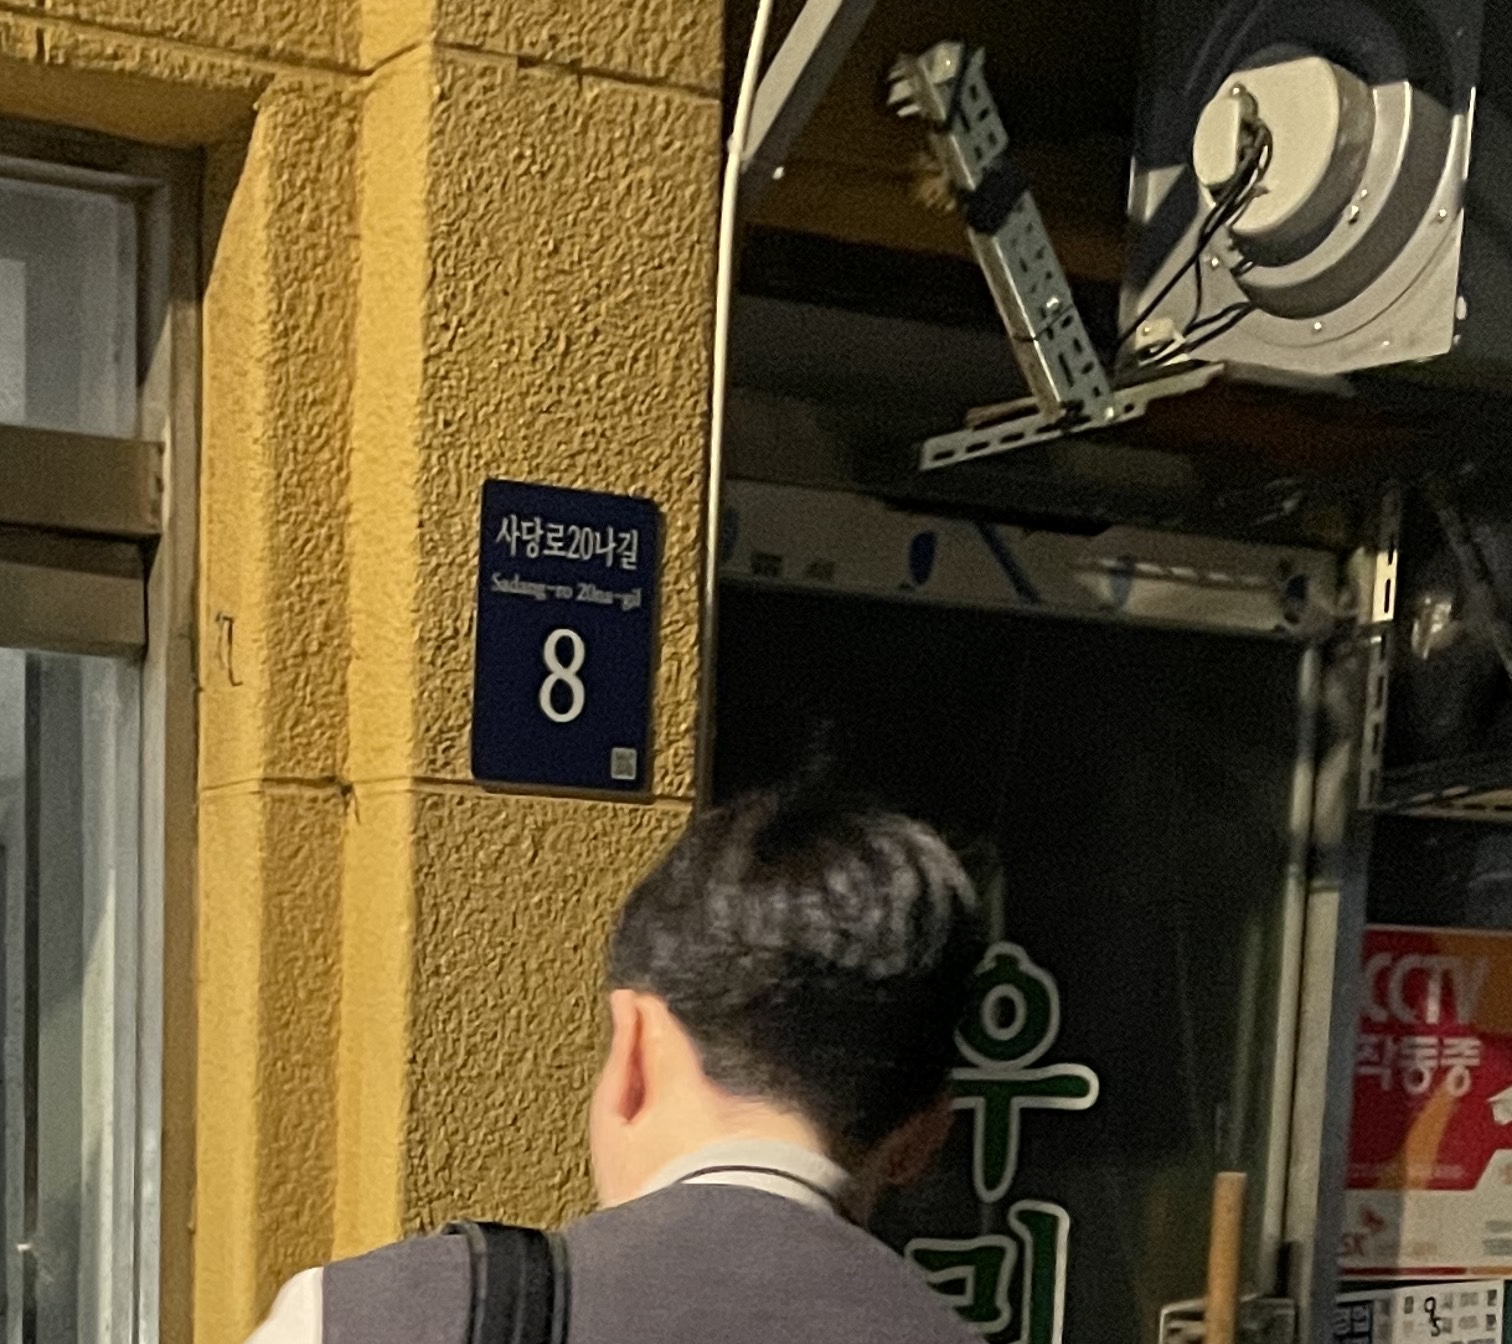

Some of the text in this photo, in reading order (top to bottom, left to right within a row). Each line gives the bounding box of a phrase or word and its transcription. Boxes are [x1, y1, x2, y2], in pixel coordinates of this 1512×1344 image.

[496, 514, 638, 570] 사당로20나길
[540, 628, 585, 723] 8
[1360, 952, 1490, 1025] CCTV
